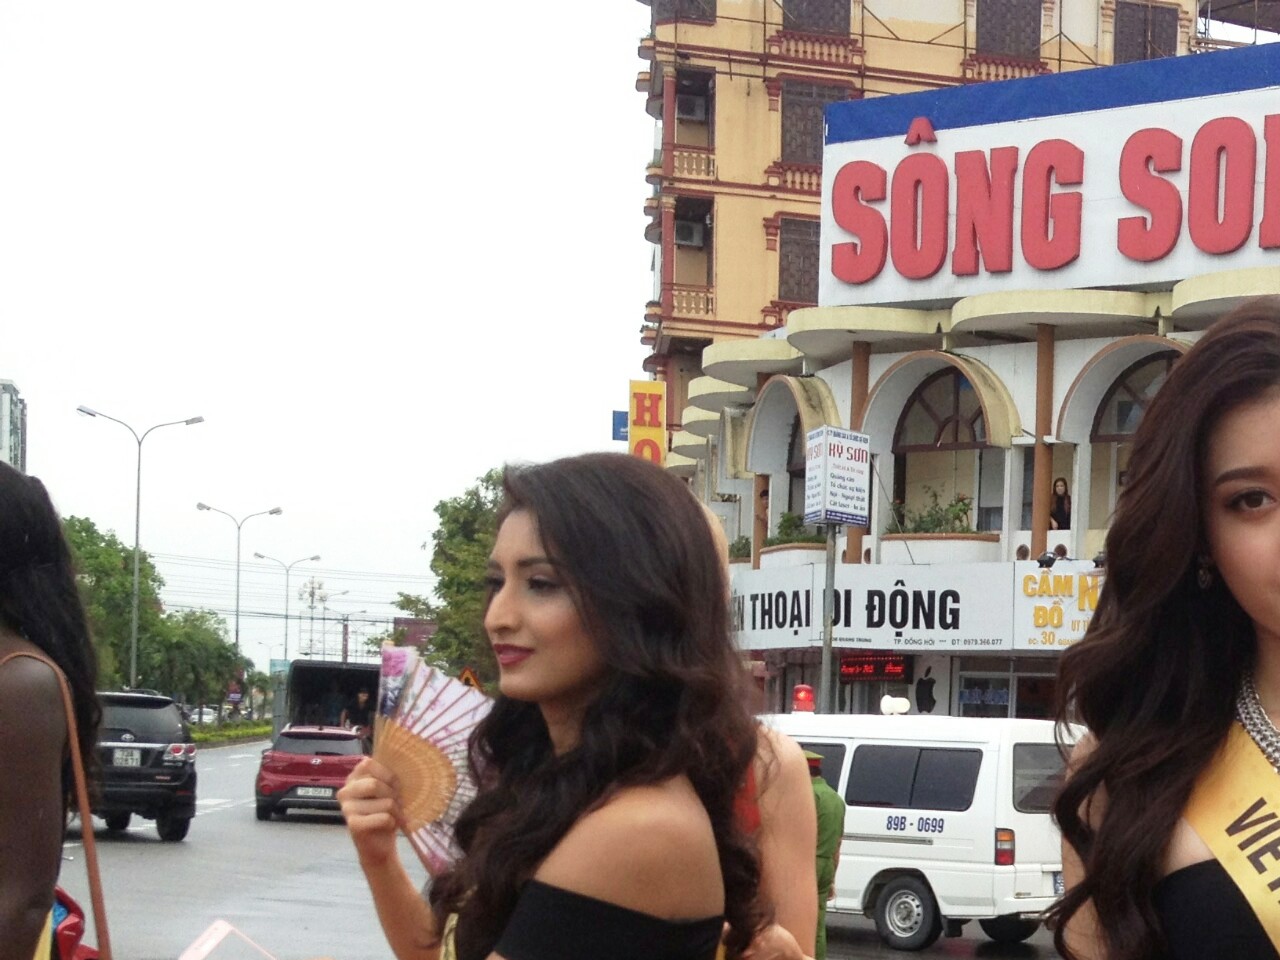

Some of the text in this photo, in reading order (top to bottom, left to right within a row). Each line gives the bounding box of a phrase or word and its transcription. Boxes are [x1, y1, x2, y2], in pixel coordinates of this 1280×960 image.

[830, 116, 1084, 285] SÔNG
[750, 590, 811, 636] THOẠI
[865, 579, 961, 637] ĐỘNG
[886, 815, 907, 831] 89B
[917, 816, 945, 833] 0699
